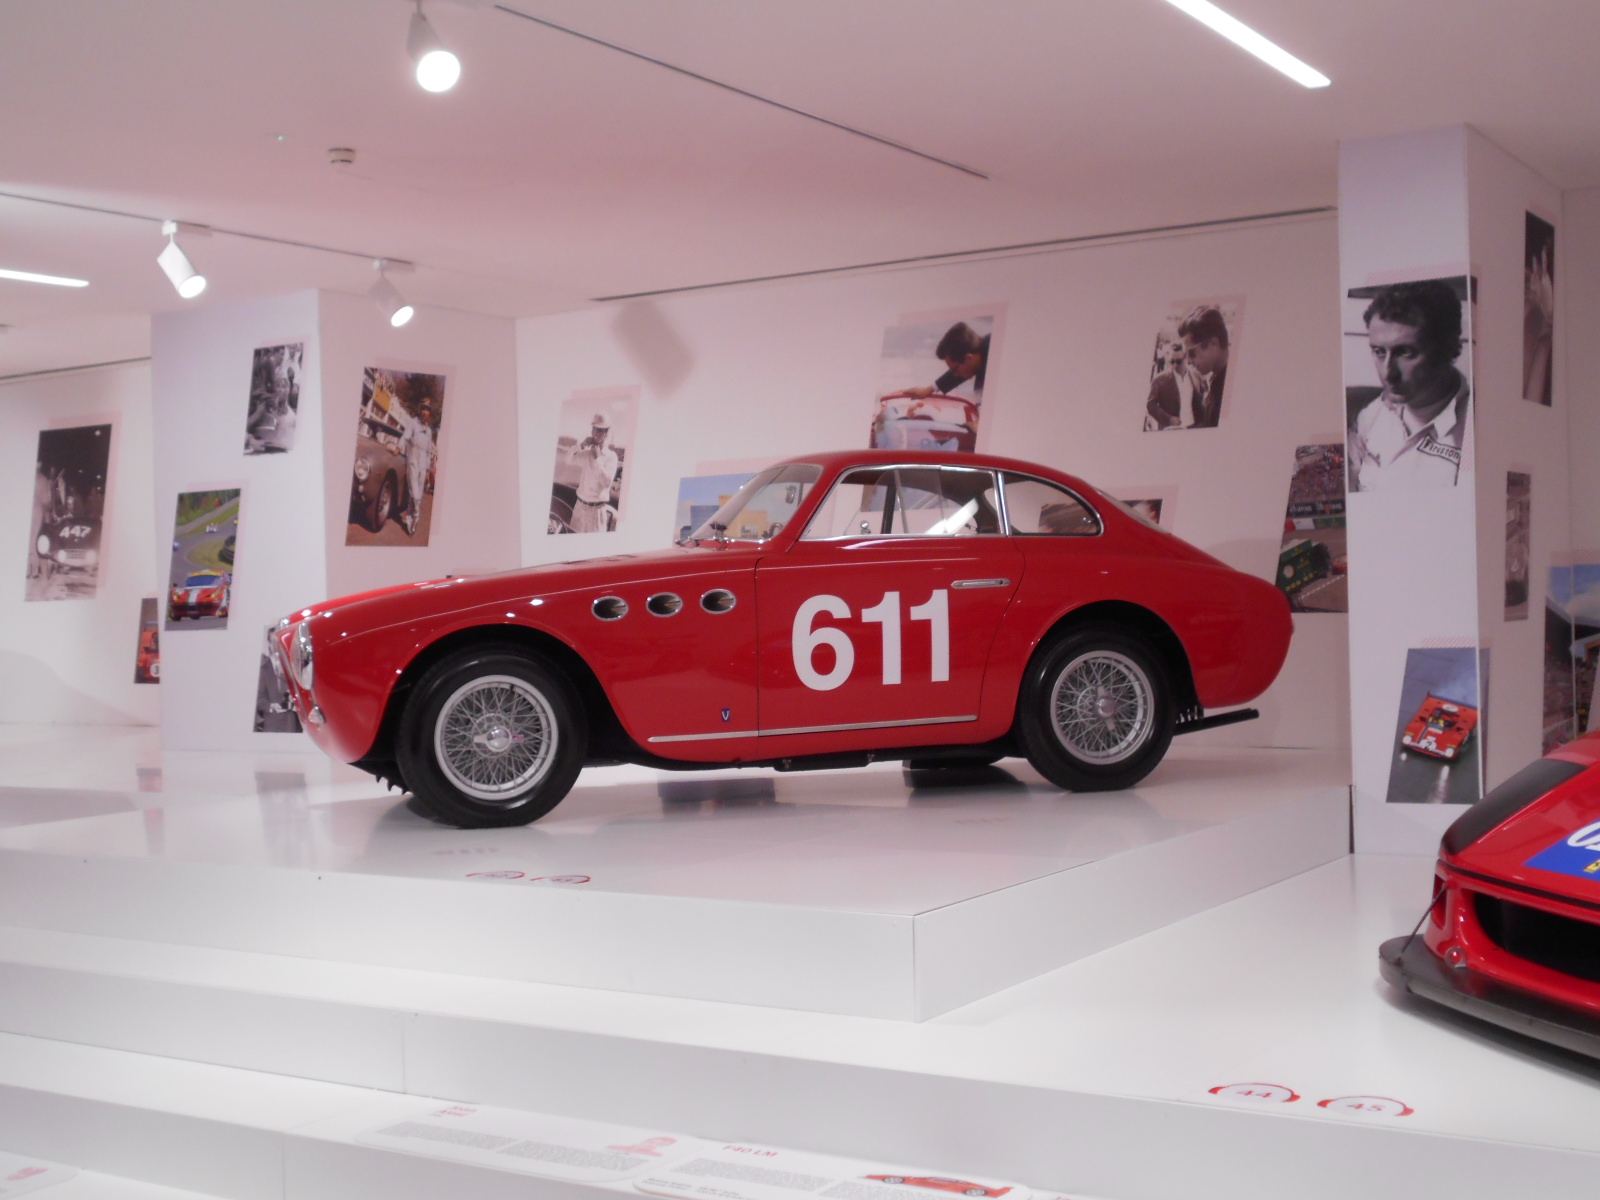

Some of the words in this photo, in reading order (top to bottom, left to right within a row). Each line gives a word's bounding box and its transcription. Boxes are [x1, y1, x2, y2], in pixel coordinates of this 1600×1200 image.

[59, 525, 92, 538] 447
[792, 589, 949, 691] 611
[1236, 1090, 1273, 1098] 44
[1346, 1103, 1387, 1112] 45
[722, 1144, 753, 1154] F40
[753, 1149, 779, 1158] LM
